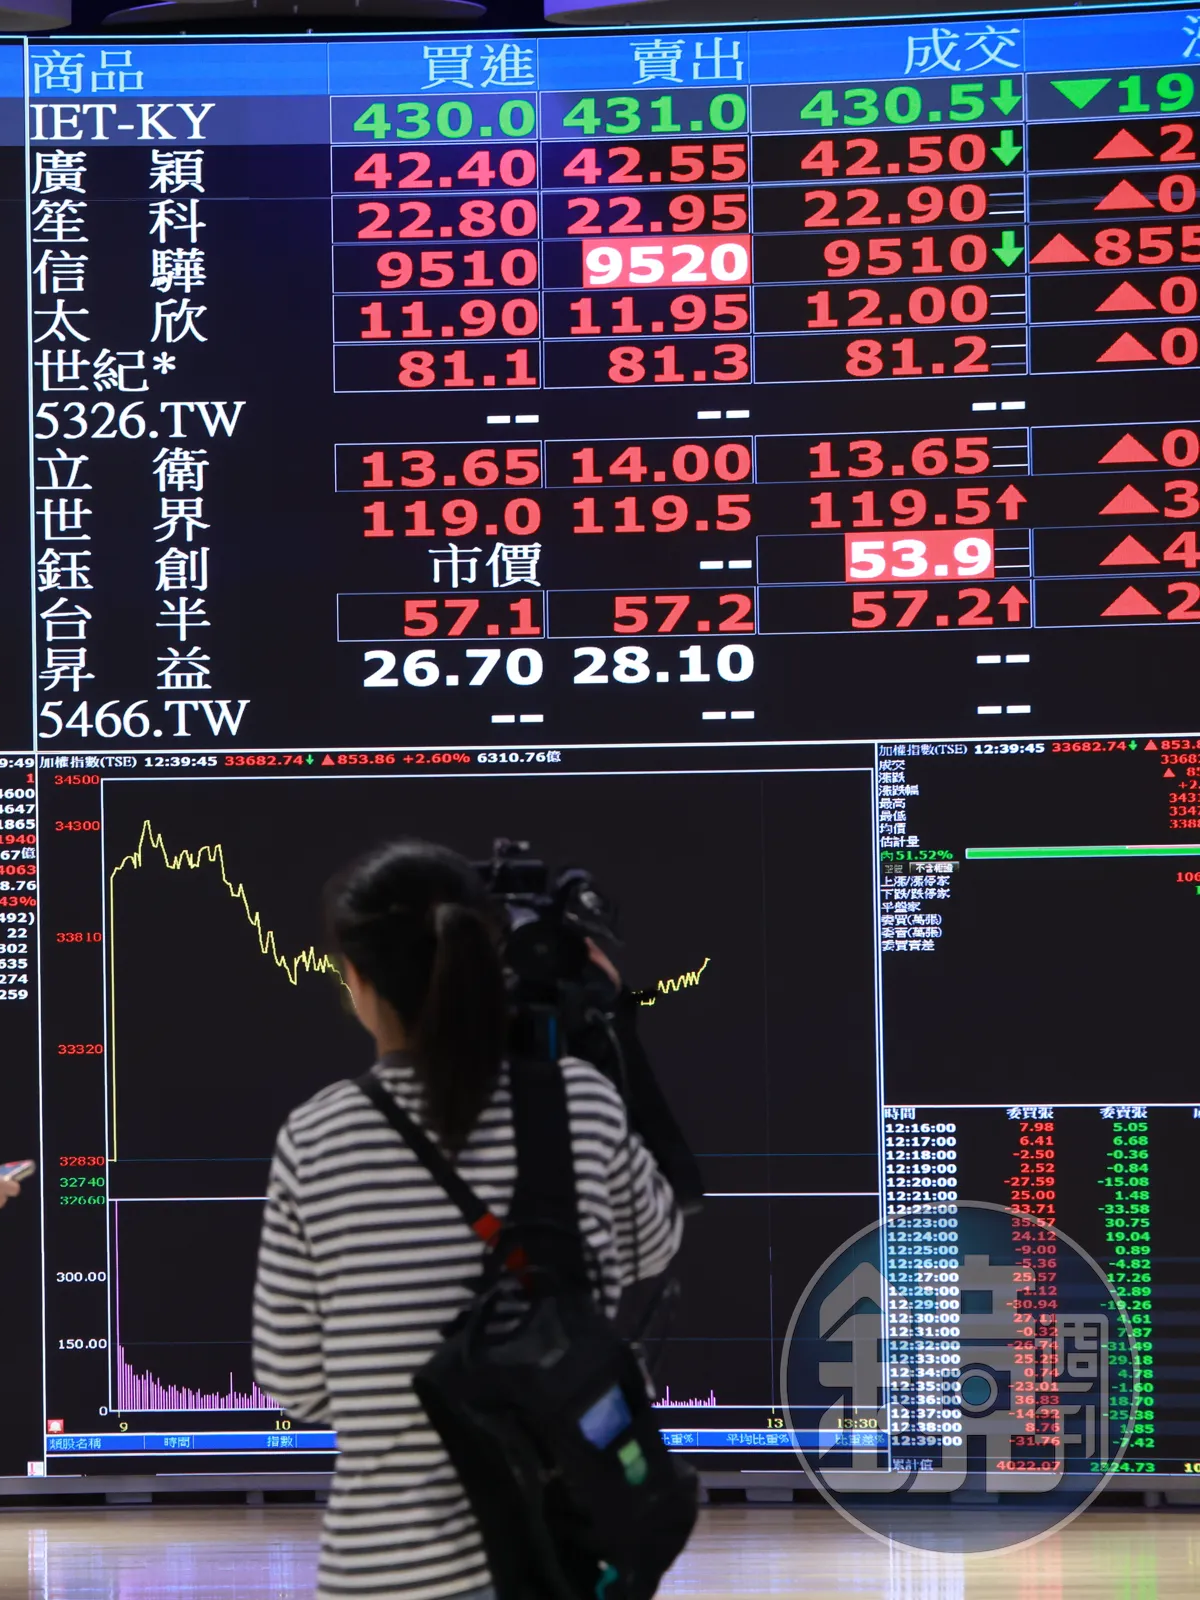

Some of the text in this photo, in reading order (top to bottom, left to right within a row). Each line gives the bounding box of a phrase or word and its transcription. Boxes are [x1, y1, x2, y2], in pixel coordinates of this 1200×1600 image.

[31, 24, 1023, 93] 商品 買進 賣出 成交
[29, 83, 984, 142] IET-KY 430.0 431.0 430.5
[377, 235, 987, 288] 9510 9520 9510
[398, 349, 536, 388] 81.1
[608, 344, 748, 383] 81.3
[846, 336, 989, 377] 81.2
[33, 401, 246, 441] 5326.TW
[363, 437, 989, 487] 13.65 14.00 13.65
[428, 538, 991, 588] 市價 53.9
[404, 588, 993, 636] 57.1 57.2 57.2
[364, 644, 754, 687] 26.70 28.10
[39, 700, 250, 738] 5466.TW
[974, 742, 1046, 755] 12:39:45
[1051, 740, 1127, 753] 33682.74
[144, 755, 218, 768] 12:39:45
[224, 754, 304, 767] 33682.74
[337, 753, 396, 765] 853.86
[402, 752, 471, 764] +2.60%
[26, 772, 35, 784] 1
[54, 774, 100, 785] 34500
[879, 798, 906, 809] 最高
[895, 849, 954, 861] 51.52%
[56, 932, 102, 943] 33810
[58, 1043, 104, 1055] 33320
[884, 1108, 915, 1119] 時間
[885, 1121, 1149, 1134] 12:16:00 7.98 5.05
[59, 1156, 105, 1167] 32830
[60, 1176, 105, 1188] 32740
[886, 1176, 1150, 1188] 12:20:00 -27.59 -15.08
[57, 1271, 106, 1283] 300.00
[58, 1338, 108, 1350] 150.00
[119, 1418, 878, 1432] 9 10 13 13:30
[267, 1435, 293, 1447] 指數
